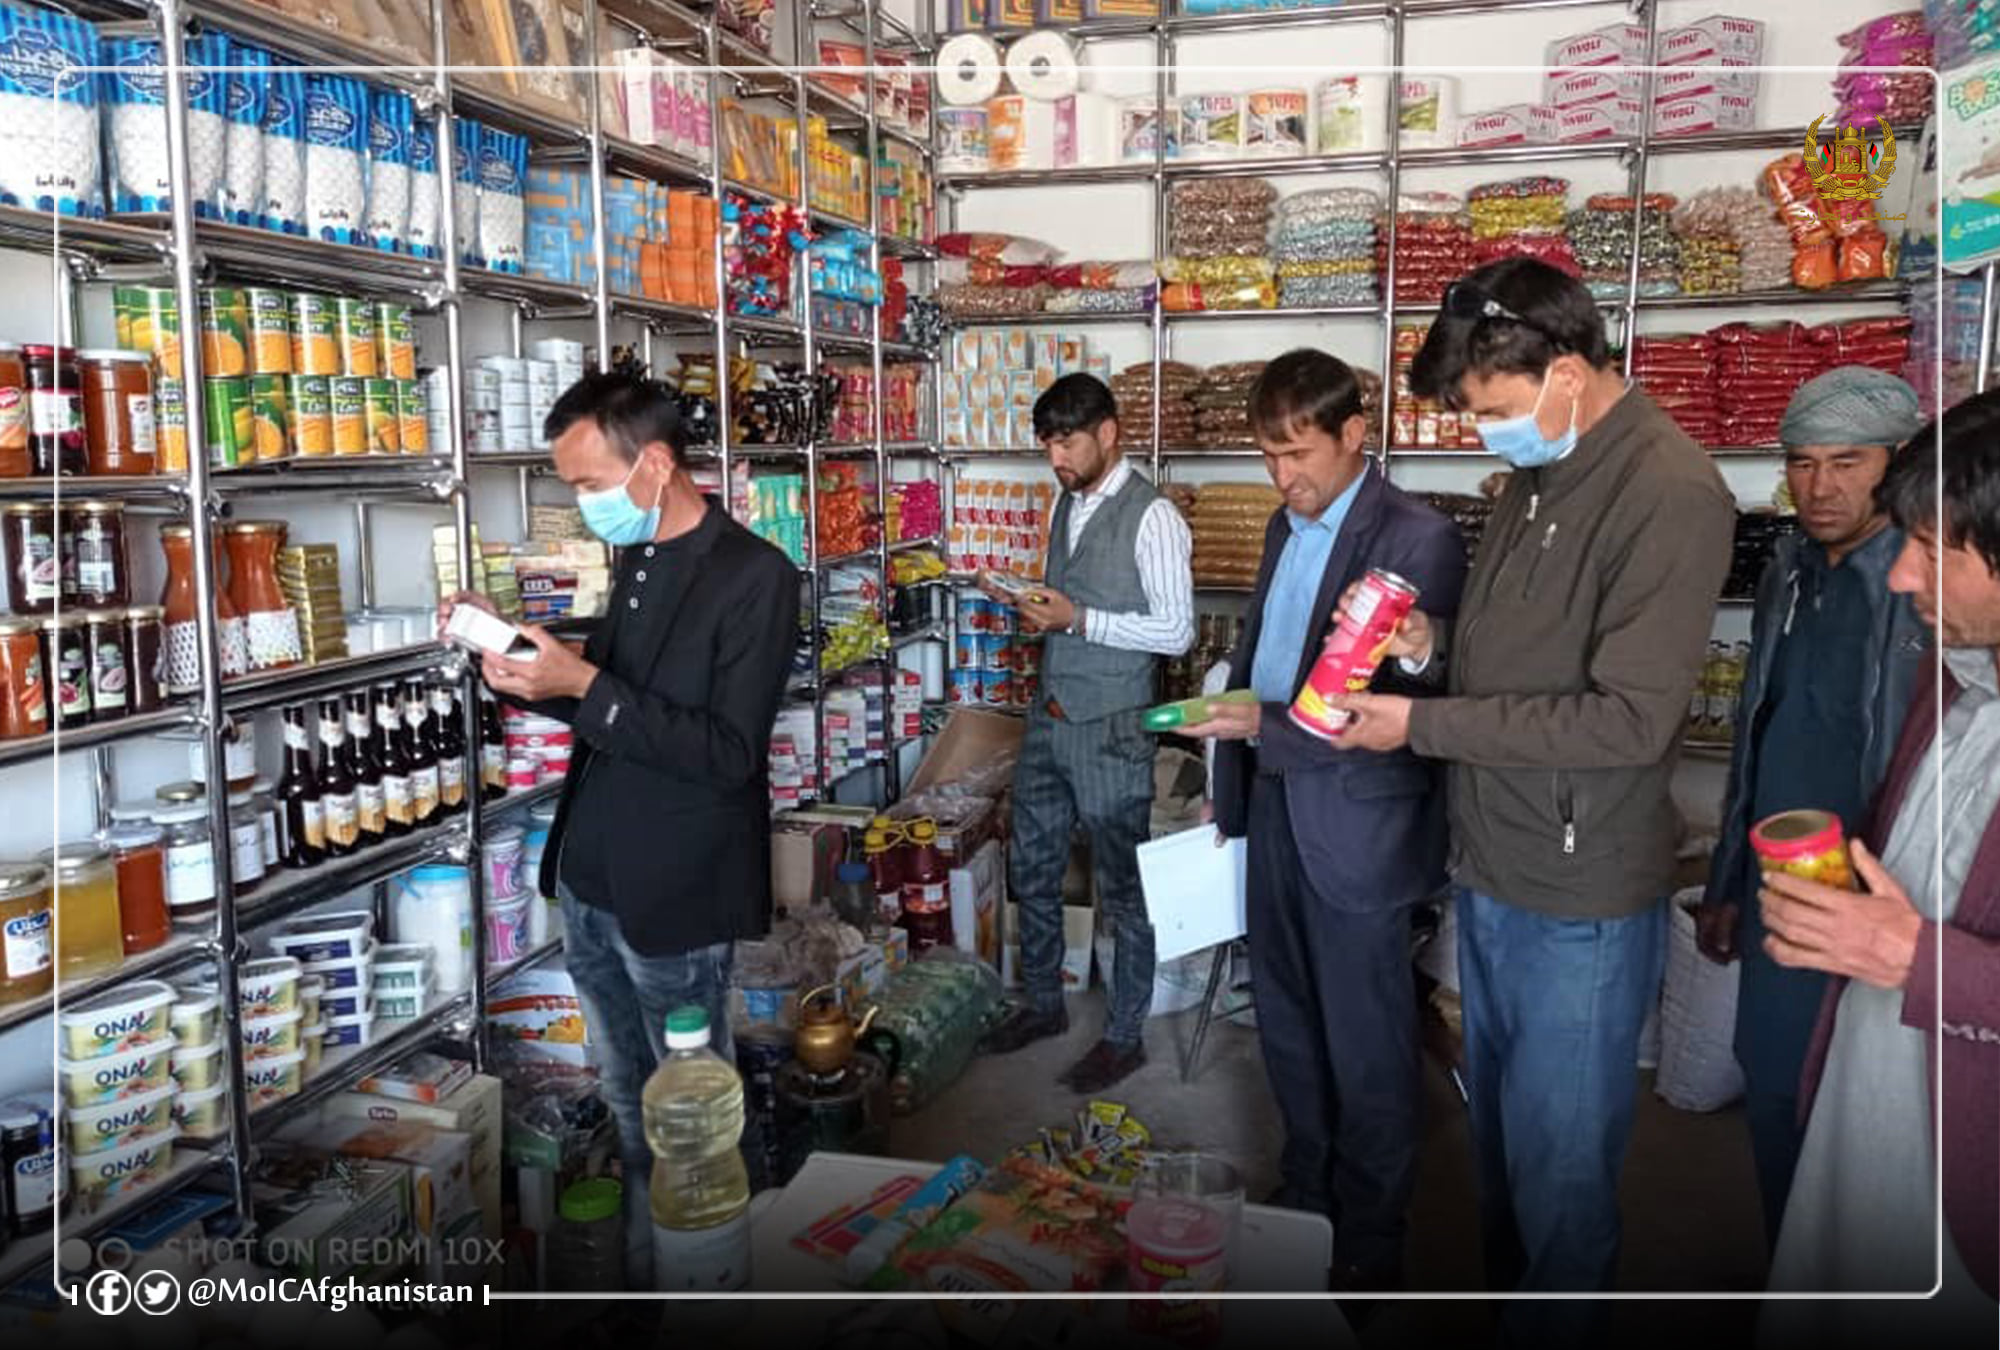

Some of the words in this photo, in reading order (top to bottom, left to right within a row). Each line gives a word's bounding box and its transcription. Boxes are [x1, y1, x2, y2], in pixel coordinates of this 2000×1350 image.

[1722, 21, 1755, 33] TIVOLI
[1568, 39, 1602, 57] TIVOLI
[1668, 32, 1699, 49] TIVOLI
[1565, 76, 1599, 92] TIVOLI
[1721, 96, 1754, 108] TIVOLI
[1662, 106, 1695, 120] TIVOLI
[1474, 117, 1508, 131] TIVOLI
[94, 1013, 145, 1039] ONA
[95, 1060, 146, 1087] ONA
[97, 1107, 147, 1135] ONA
[101, 1152, 149, 1179] ONA
